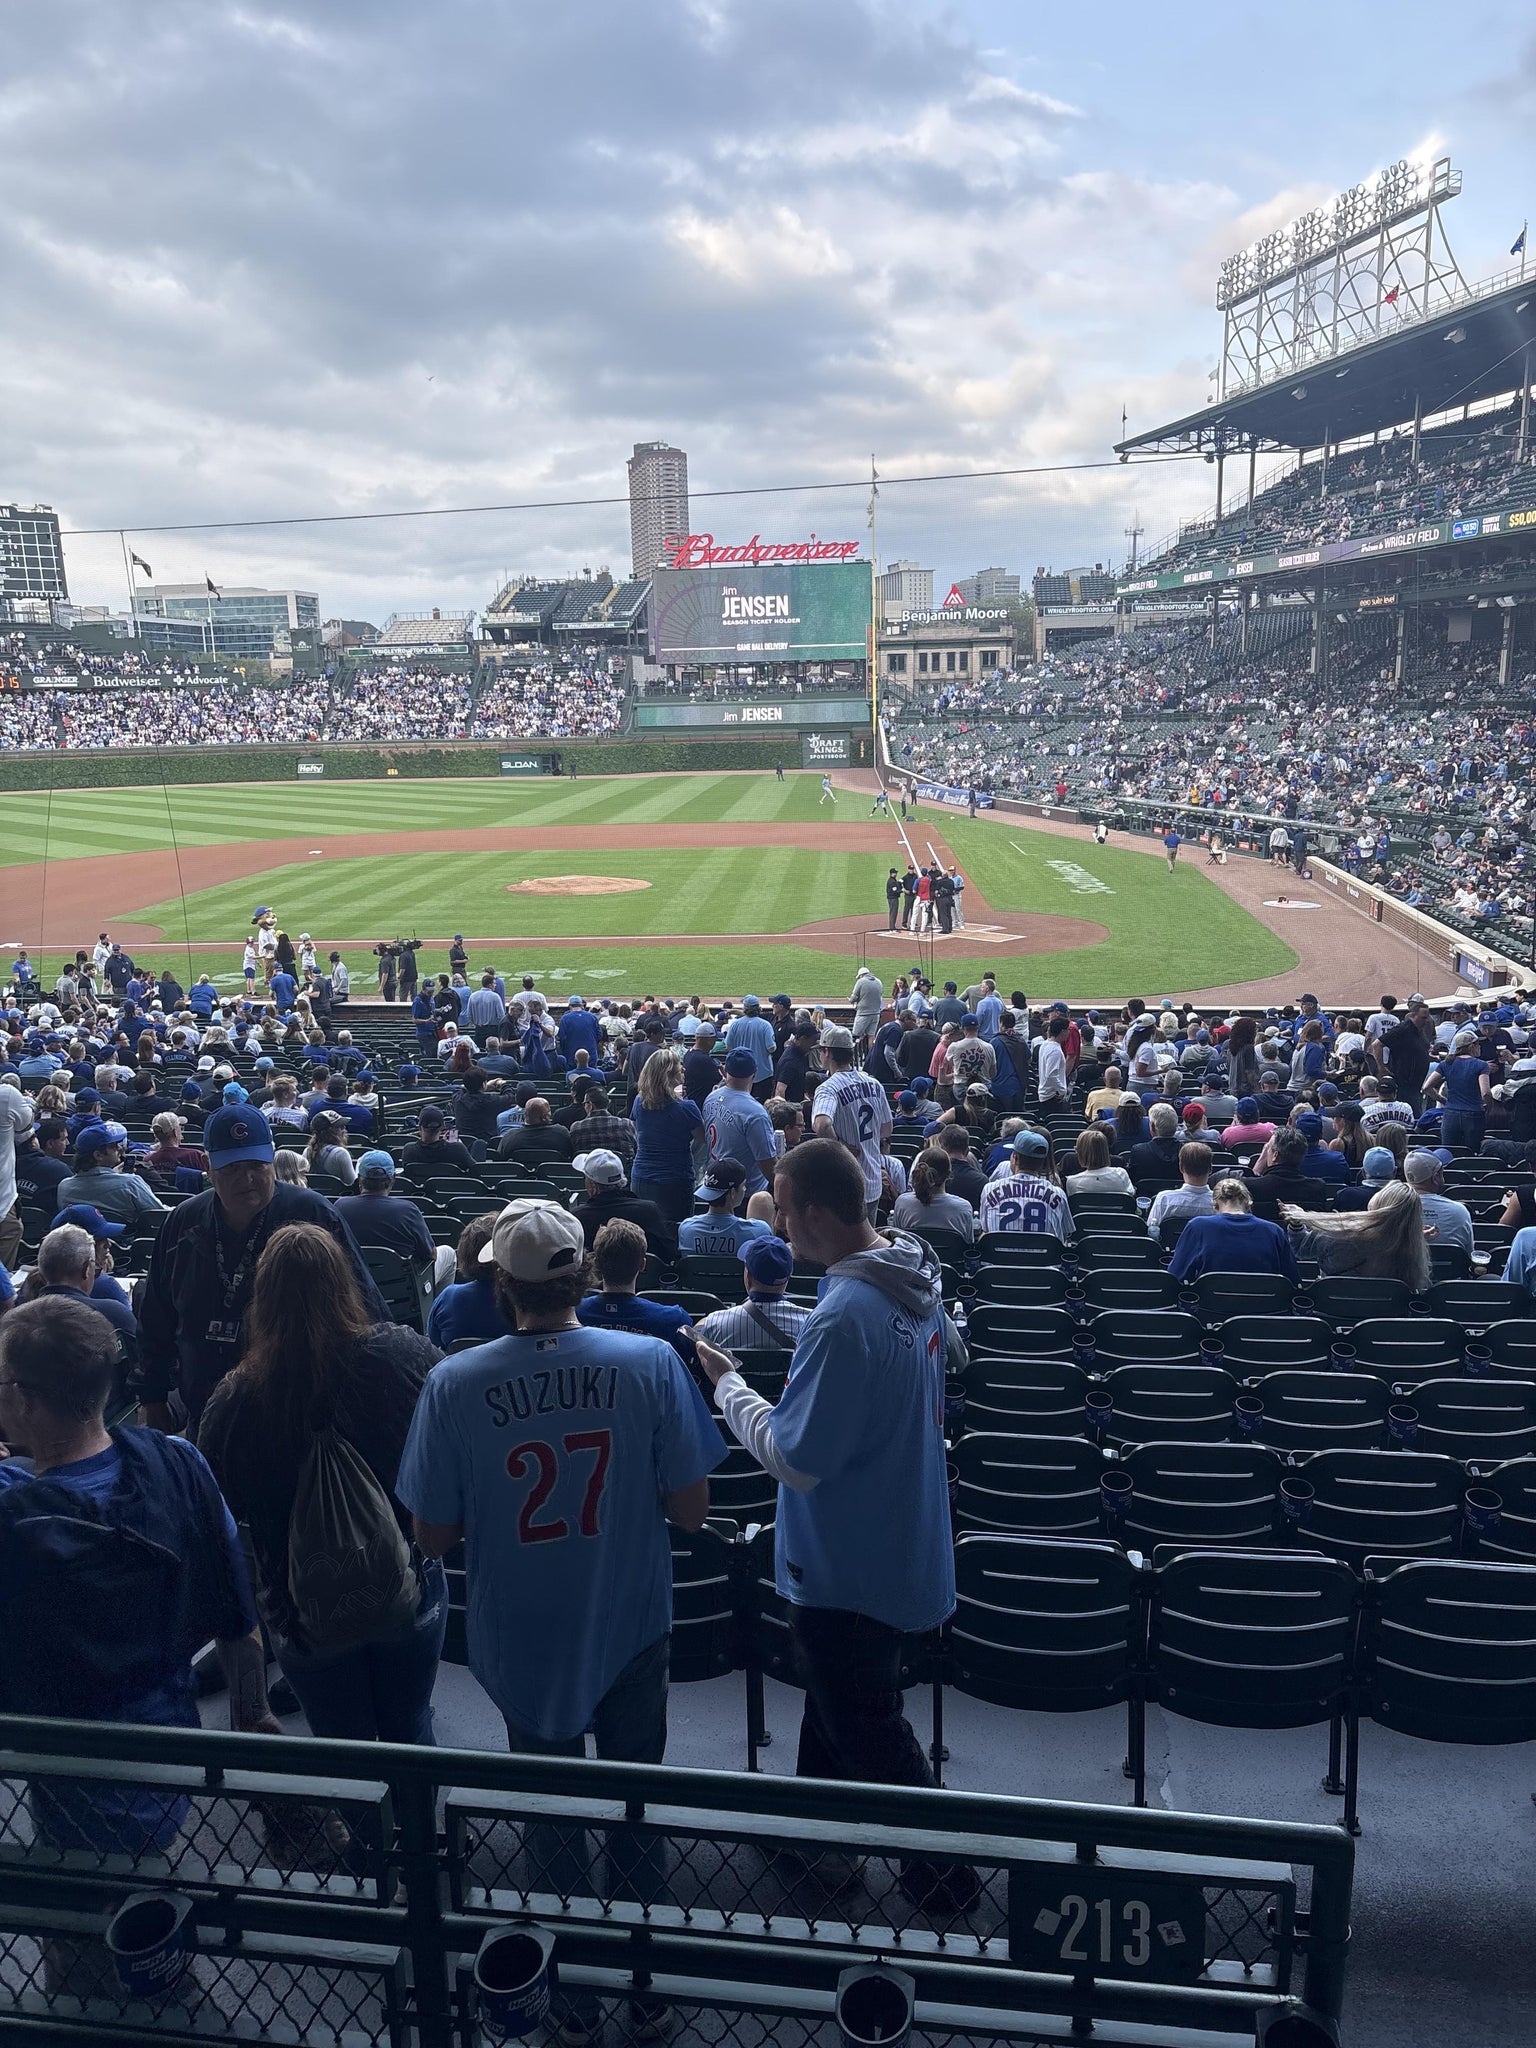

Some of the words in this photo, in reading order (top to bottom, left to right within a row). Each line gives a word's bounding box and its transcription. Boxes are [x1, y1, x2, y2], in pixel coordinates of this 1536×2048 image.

[1482, 524, 1500, 534] TOTAL
[1384, 533, 1417, 549] WRIGLEY
[1417, 528, 1440, 543] FIELD
[664, 533, 860, 568] Budweiser
[1236, 562, 1253, 575] JENSEN
[722, 586, 737, 596] Jim
[721, 595, 789, 618] JENSEN
[902, 607, 961, 624] Benjamin
[966, 608, 1008, 619] Moore
[736, 643, 751, 651] GAME
[764, 642, 789, 650] DELIVERY
[33, 676, 79, 684] GRAINGER
[187, 675, 229, 685] Advocate
[722, 712, 738, 722] Jim
[741, 707, 782, 721] JENSEN
[810, 739, 845, 748] DRAFT
[299, 764, 322, 773] Hefty
[501, 761, 538, 769] SLOAN
[838, 1082, 881, 1107] HOERNER
[858, 1104, 874, 1142] 2
[1367, 1110, 1412, 1126] SCHWARBER
[987, 1180, 1062, 1210] HENDRICKS
[999, 1201, 1047, 1232] 28
[694, 1236, 735, 1254] RIZZO
[484, 1366, 620, 1428] SUZUKI
[506, 1429, 612, 1545] 27
[1059, 1894, 1151, 1968] 213
[133, 1952, 165, 1970] Hefty
[511, 1989, 540, 2010] Hefty
